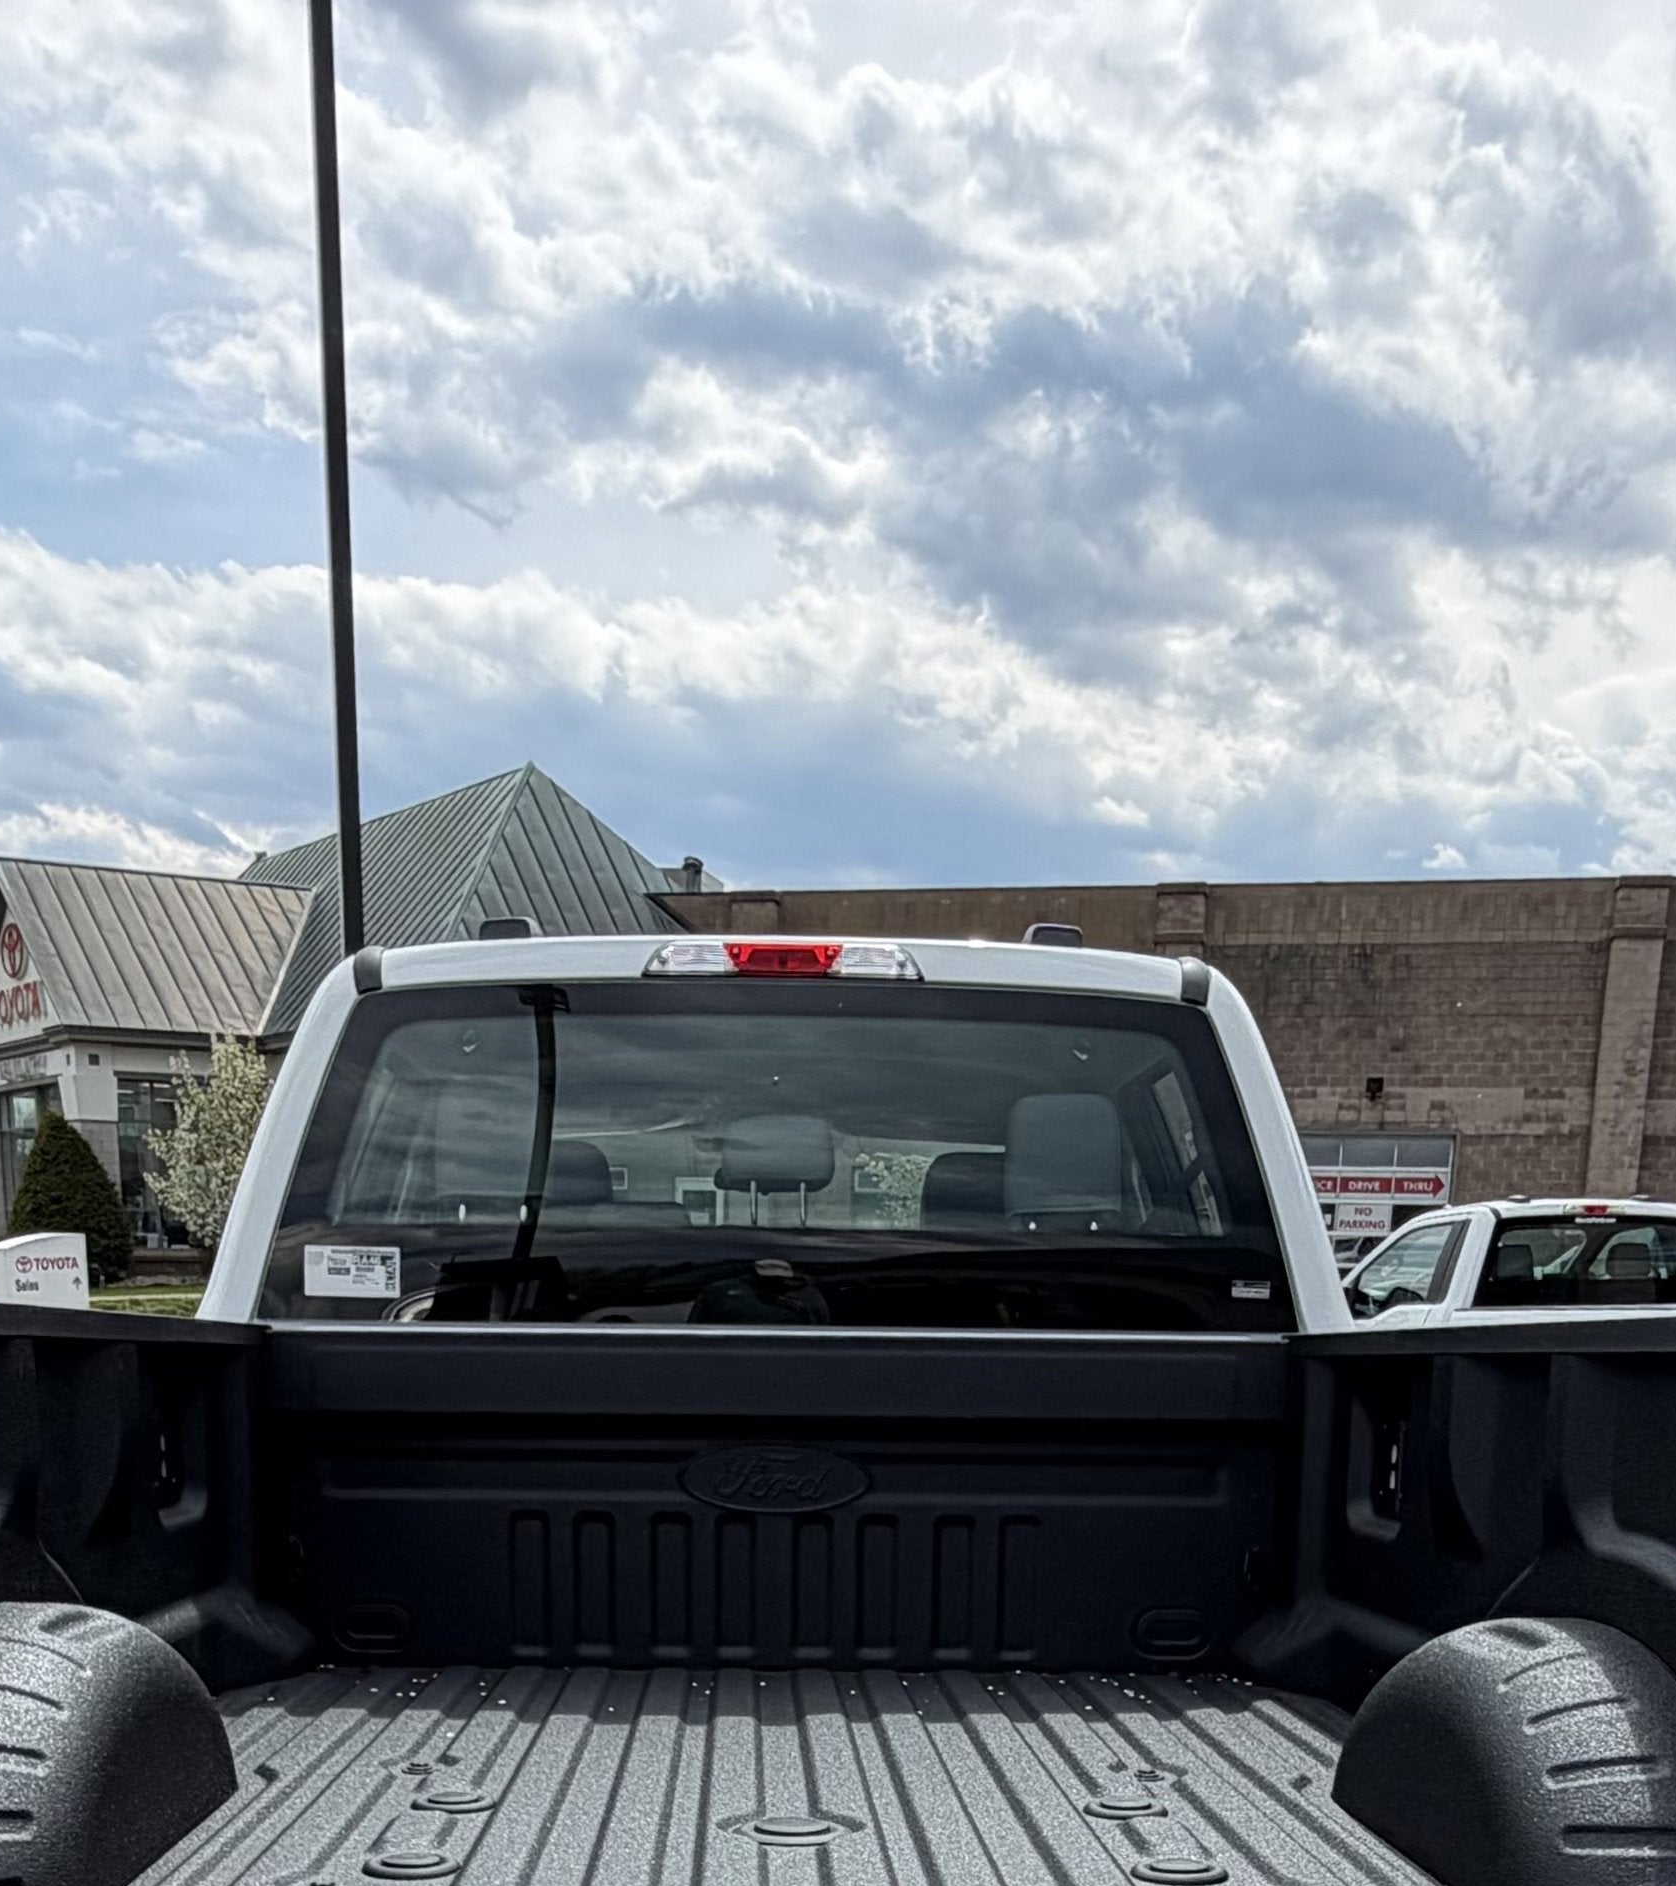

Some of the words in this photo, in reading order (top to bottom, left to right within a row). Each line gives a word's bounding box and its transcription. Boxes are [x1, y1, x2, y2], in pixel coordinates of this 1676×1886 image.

[1348, 1181, 1380, 1191] DRIVE
[1403, 1181, 1434, 1191] THRU
[1354, 1207, 1373, 1216] NO
[1339, 1220, 1385, 1229] PARKING
[34, 1257, 79, 1271] TOYOTA
[15, 1279, 39, 1292] Sales
[713, 1453, 835, 1500] Ford
